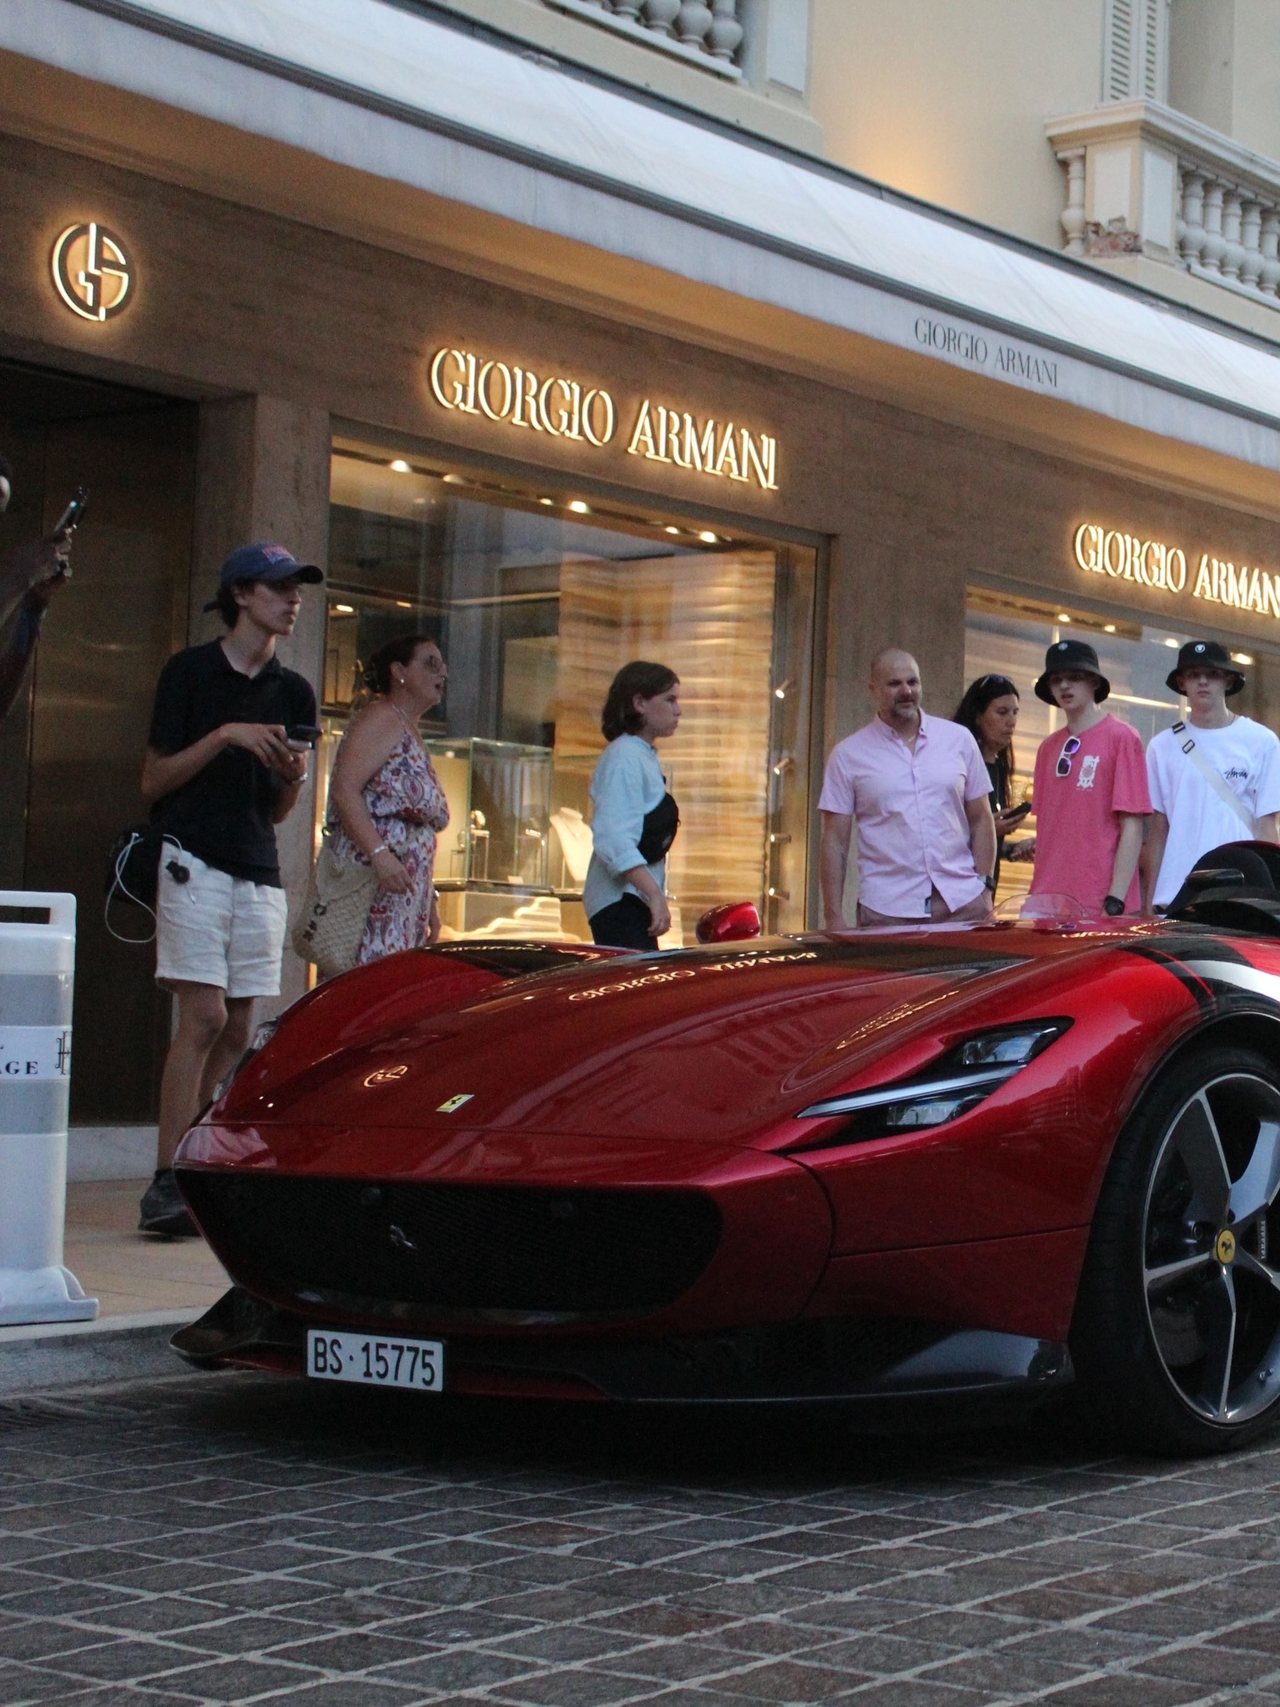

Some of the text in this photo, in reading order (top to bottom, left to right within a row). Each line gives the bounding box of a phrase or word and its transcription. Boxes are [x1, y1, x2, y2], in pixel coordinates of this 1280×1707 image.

[914, 317, 1057, 388] GIORGIO ARMANI
[431, 347, 779, 490] GIORGIO ARMANI
[1075, 523, 1187, 593] GIORGIO
